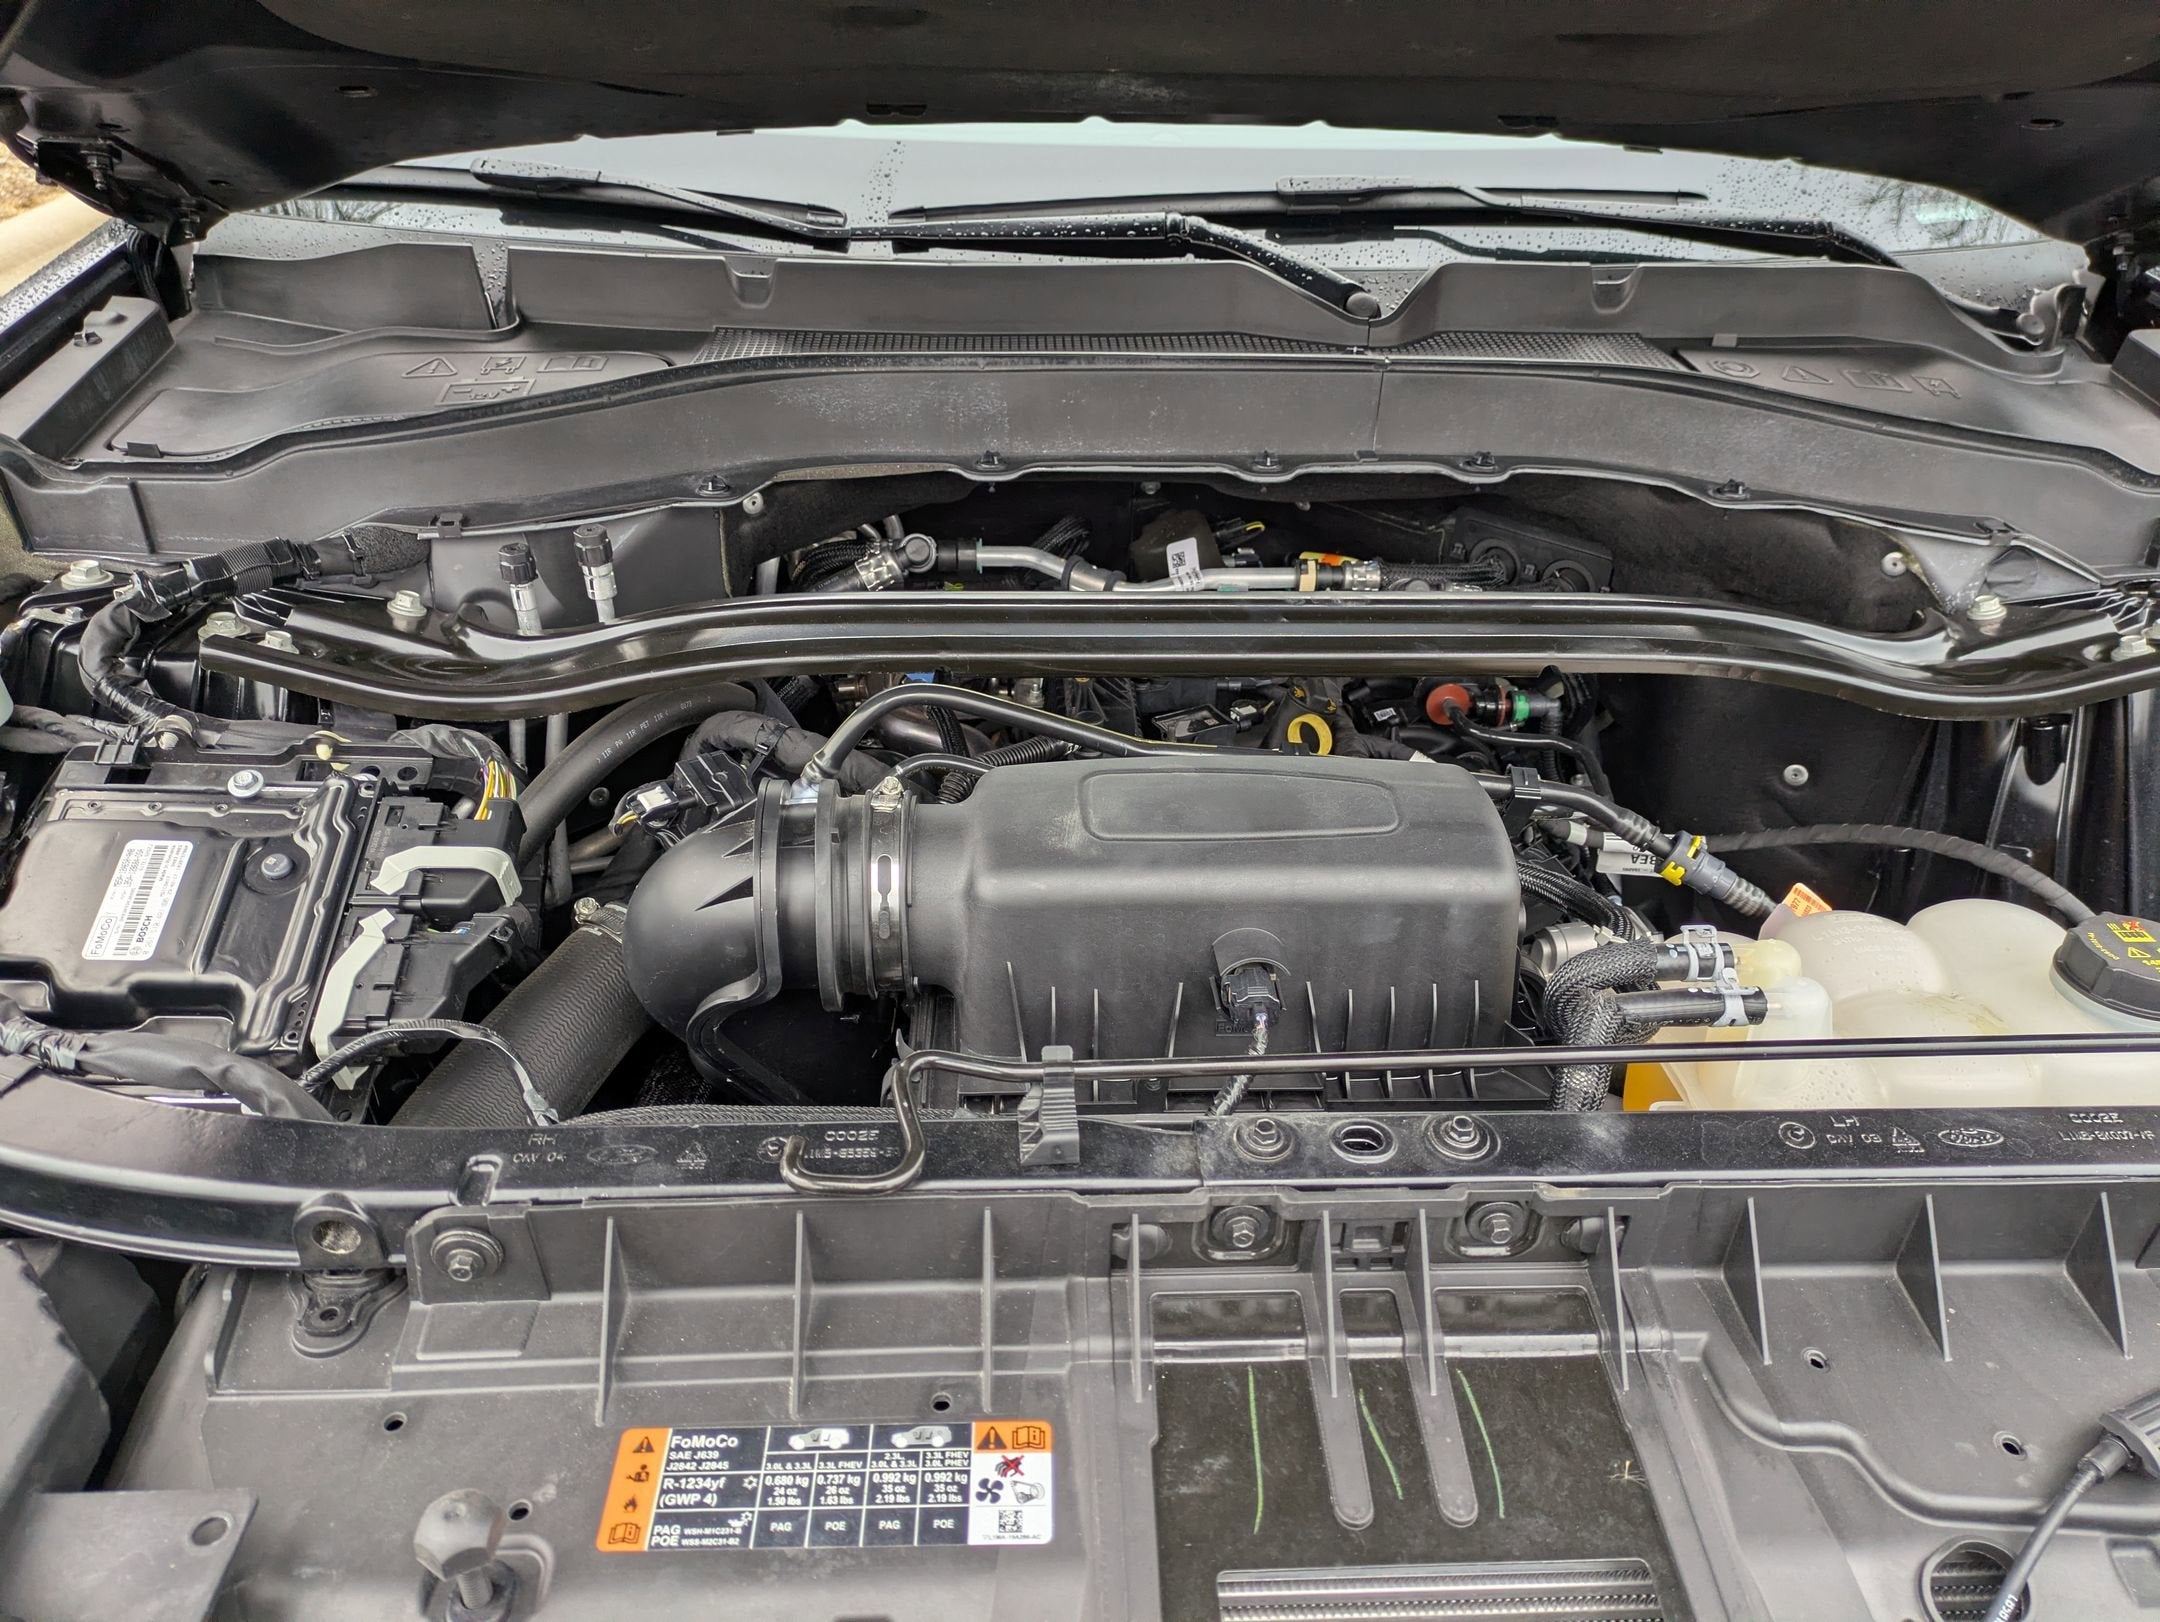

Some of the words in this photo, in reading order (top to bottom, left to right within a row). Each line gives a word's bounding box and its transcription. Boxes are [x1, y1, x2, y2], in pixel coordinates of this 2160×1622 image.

[136, 915, 153, 943] BOSCH
[90, 918, 113, 955] FoMoCo
[1829, 1116, 1860, 1127] LH
[528, 1133, 558, 1145] RH
[671, 1434, 739, 1448] FoMoCo
[669, 1451, 692, 1460] SAE
[694, 1451, 719, 1460] J639
[925, 1452, 944, 1460] 3.3L
[945, 1451, 969, 1459] FHEV
[666, 1462, 697, 1471] J2842
[698, 1461, 729, 1470] J2845
[766, 1462, 783, 1470] 3.0L
[786, 1462, 792, 1470] &
[794, 1462, 812, 1470] 3.3L
[819, 1461, 836, 1469] 3.3L
[838, 1461, 863, 1469] FHEV
[871, 1460, 889, 1468] 3.0L
[891, 1460, 898, 1468] &
[899, 1460, 917, 1468] 3.3L
[944, 1459, 969, 1467] PHEV
[765, 1475, 794, 1486] 0.680
[795, 1475, 809, 1488] kg
[817, 1474, 845, 1485] 0.737
[847, 1474, 861, 1487] kg
[872, 1472, 901, 1483] 0.992
[903, 1472, 917, 1485] kg
[924, 1472, 953, 1483] 0.992
[954, 1472, 968, 1484] kg
[663, 1477, 727, 1491] R-1234yf
[881, 1484, 893, 1493] 35
[894, 1485, 906, 1493] oz
[934, 1484, 945, 1493] 35
[773, 1487, 785, 1496] 24
[825, 1486, 837, 1495] 26
[659, 1494, 701, 1508] (GWP
[703, 1493, 718, 1507] 4)
[767, 1497, 786, 1506] 1.50
[787, 1497, 802, 1505] lbs
[820, 1496, 838, 1505] 1.63
[840, 1496, 854, 1504] lbs
[875, 1494, 895, 1503] 2.19
[896, 1494, 911, 1503] lbs
[928, 1494, 947, 1503] 2.19
[948, 1494, 963, 1502] lbs
[770, 1522, 792, 1532] PAG
[825, 1521, 846, 1531] POE
[878, 1520, 901, 1530] PAG
[933, 1519, 955, 1528] POE
[653, 1525, 681, 1535] PAG
[651, 1536, 680, 1546] POE
